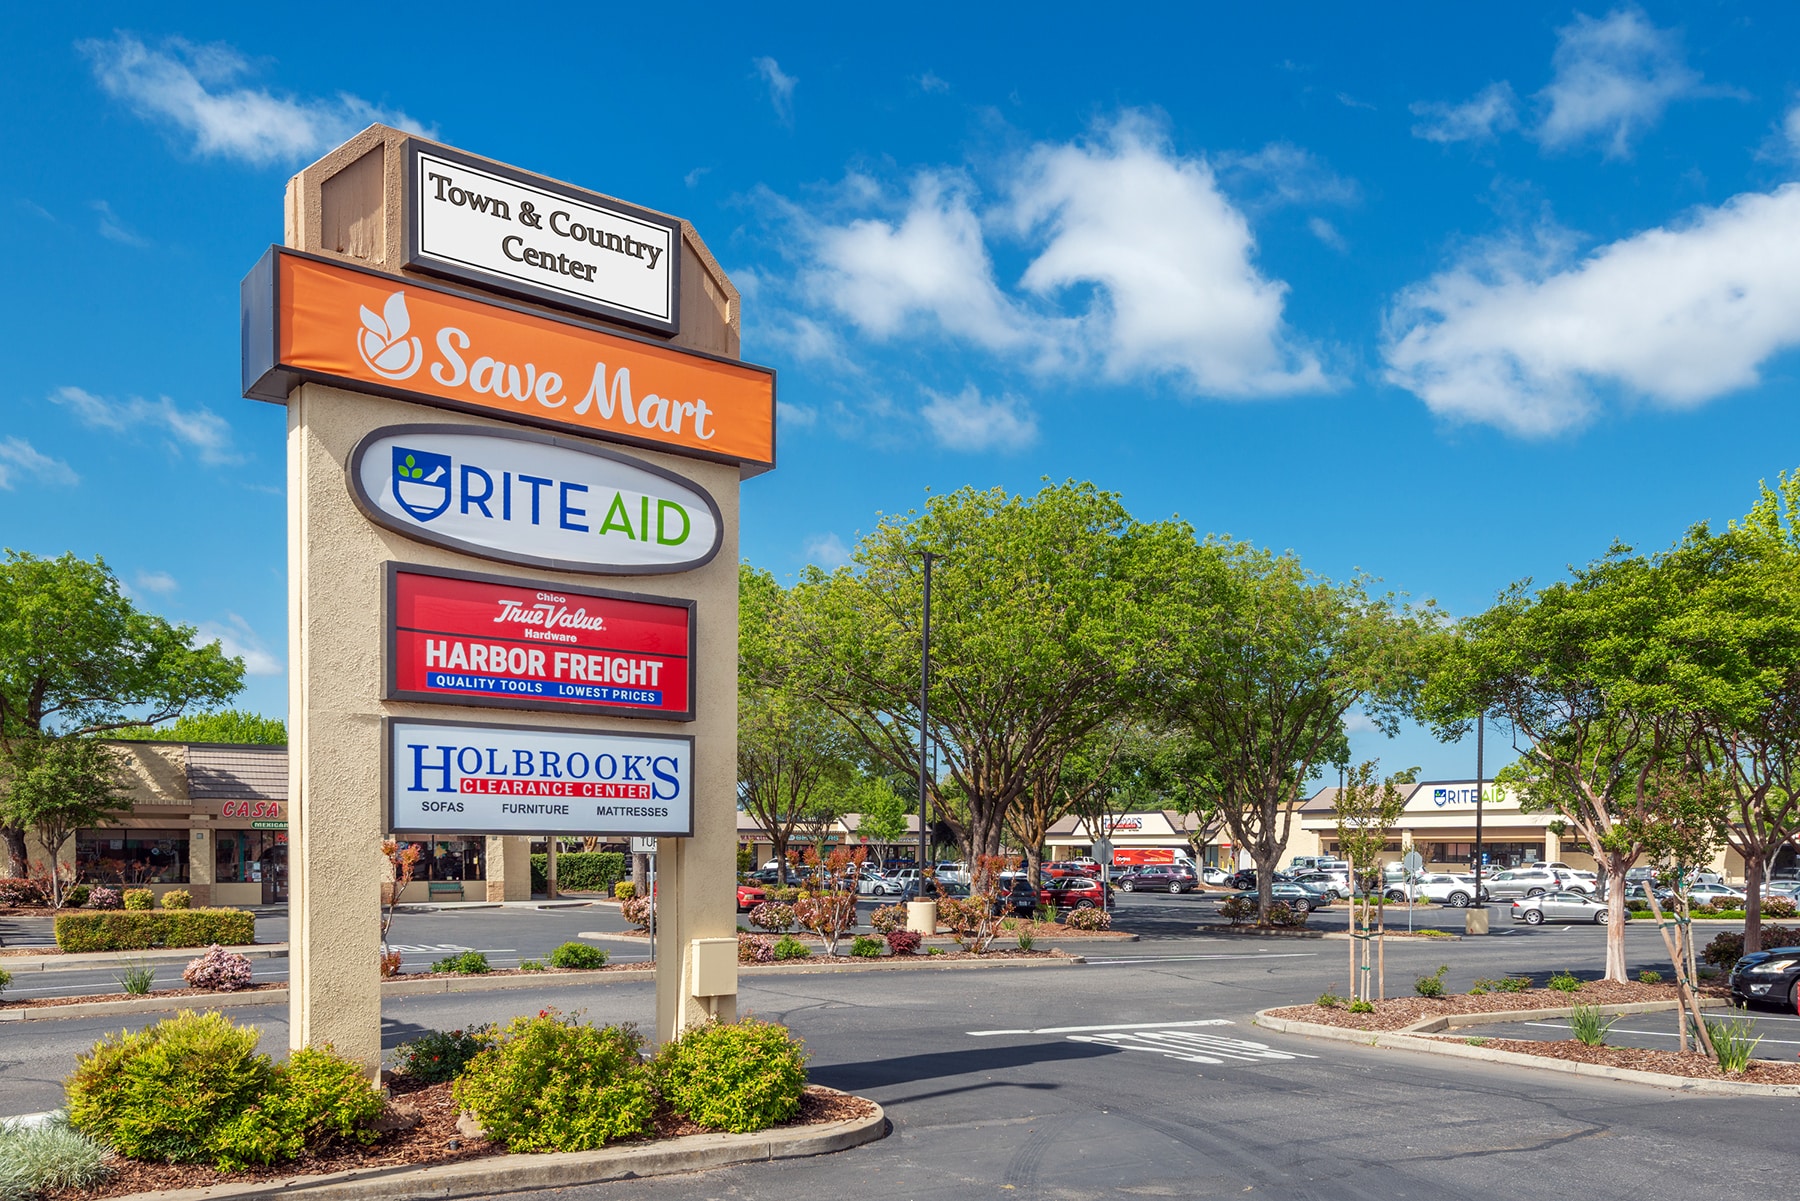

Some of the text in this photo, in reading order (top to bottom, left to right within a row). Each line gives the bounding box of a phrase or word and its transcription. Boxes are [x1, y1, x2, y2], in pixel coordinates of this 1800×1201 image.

[429, 172, 663, 269] Town & Country
[502, 235, 598, 282] Center
[430, 327, 716, 440] Save Mart
[460, 464, 691, 546] RITE AID
[536, 592, 567, 603] Chico
[524, 628, 578, 643] Hardware
[426, 639, 664, 687] HARBOR FREIGHT
[436, 675, 543, 693] QUALITY TOOLS
[559, 685, 656, 702] LOWEST PRICES
[407, 744, 680, 800] HOLBROOK'S
[462, 779, 648, 798] CLEARANCE CENTER
[1448, 788, 1505, 804] RITE AID
[222, 800, 279, 817] CASA
[421, 801, 464, 813] SOFAS
[502, 803, 569, 815] FURNITURE
[596, 806, 669, 817] MATTRESSES
